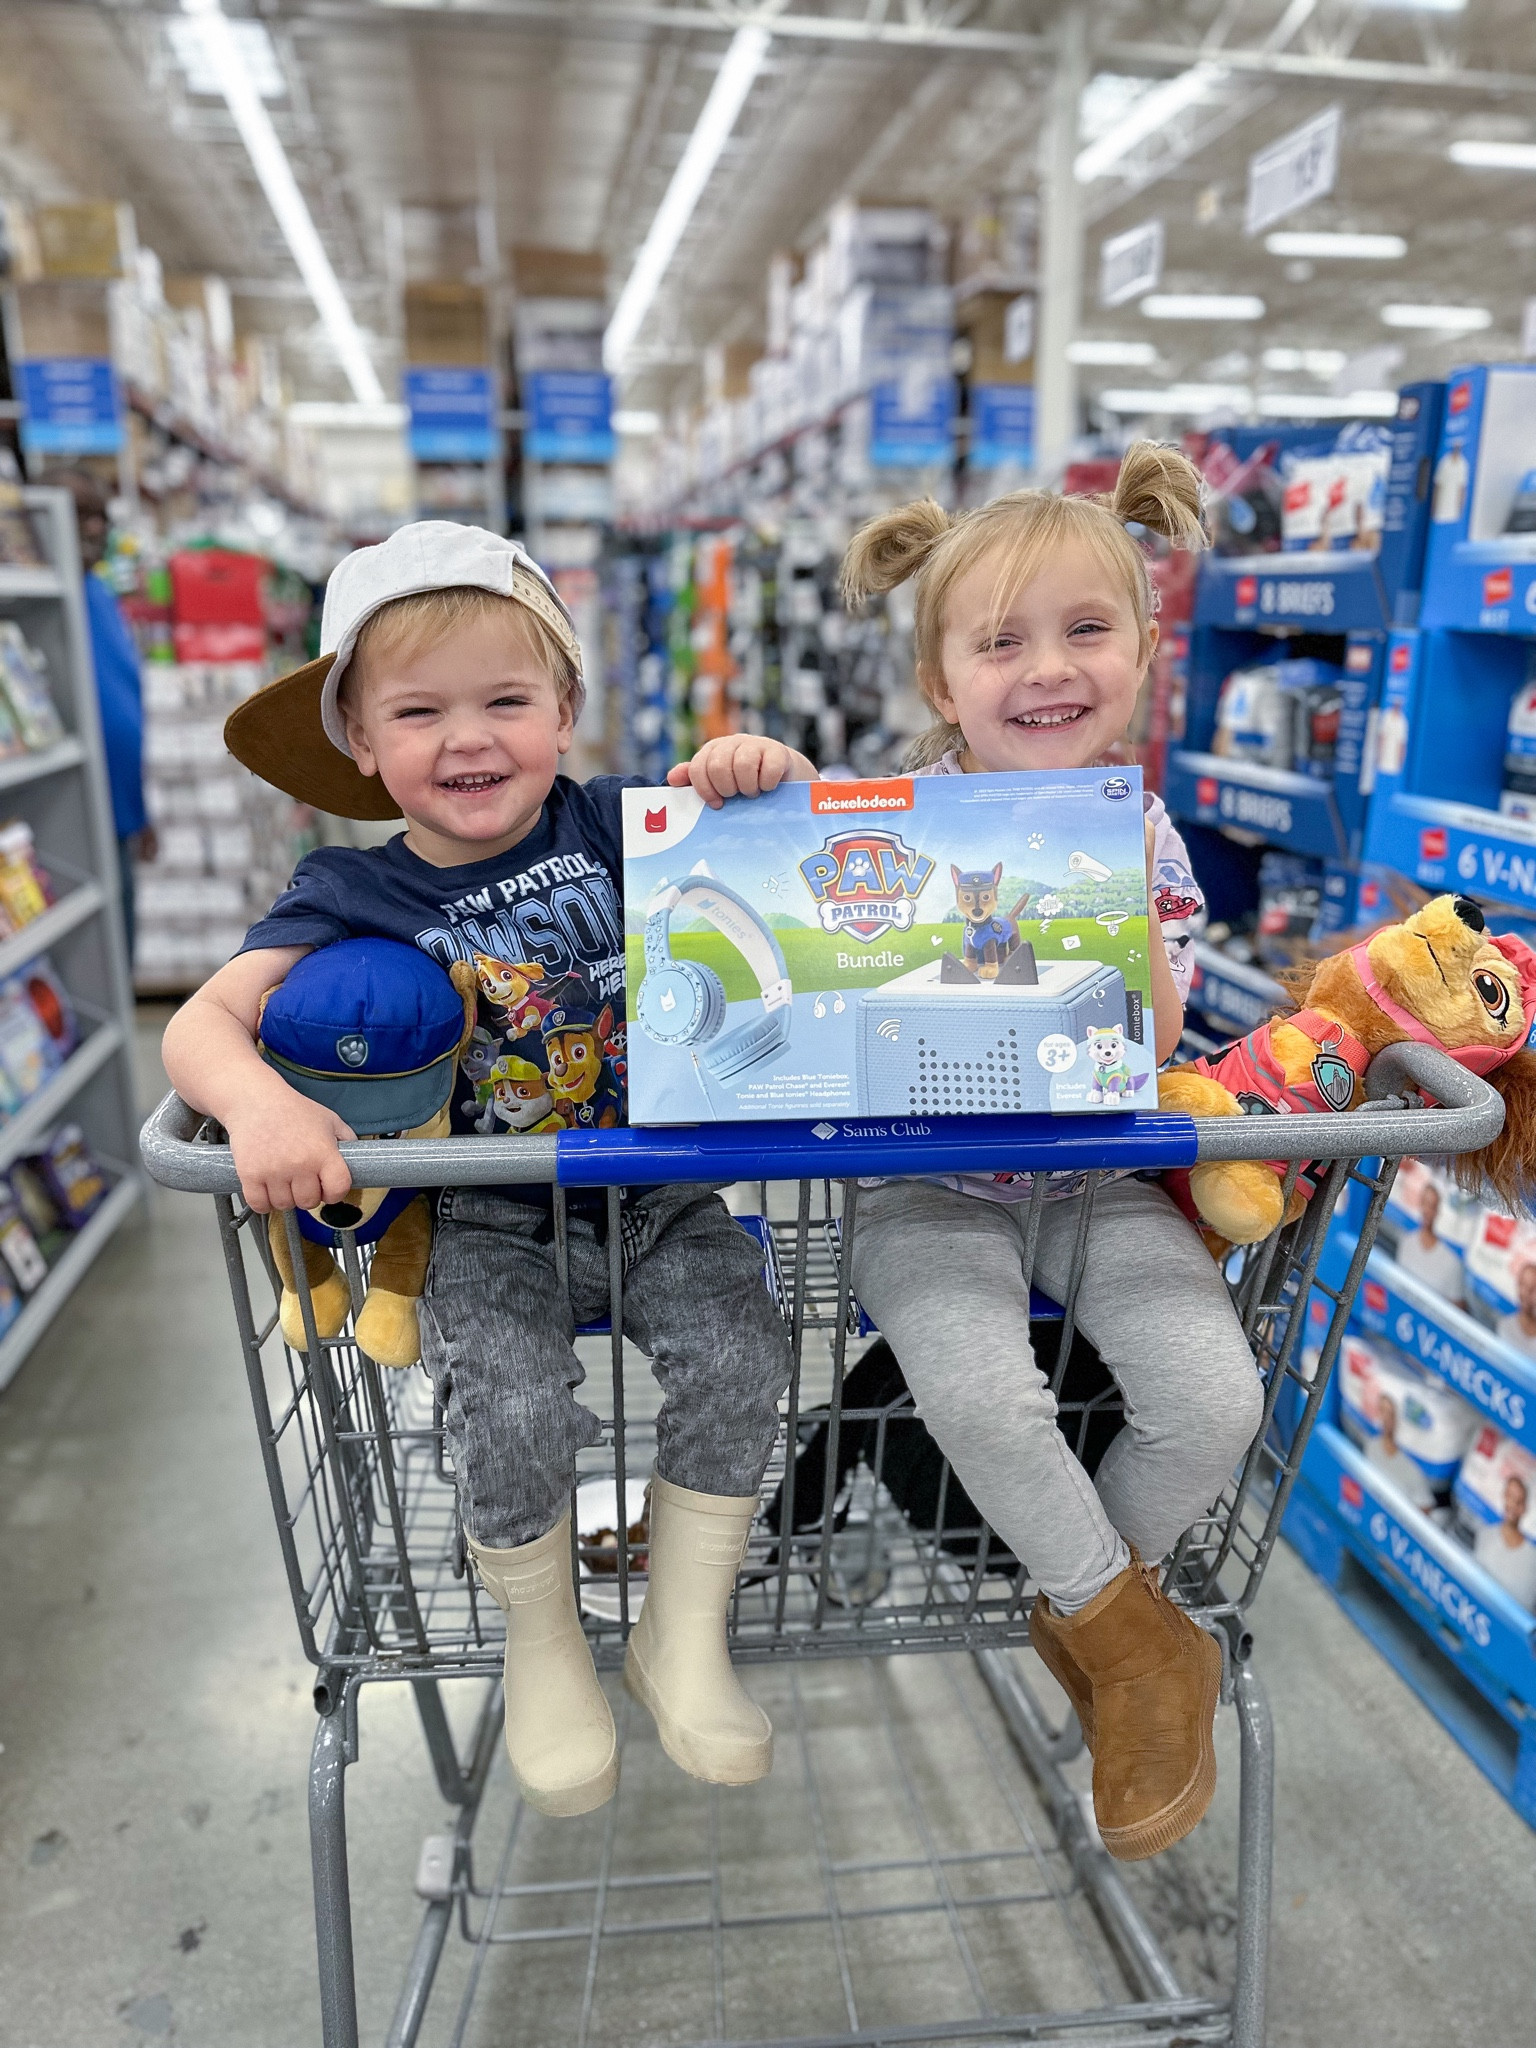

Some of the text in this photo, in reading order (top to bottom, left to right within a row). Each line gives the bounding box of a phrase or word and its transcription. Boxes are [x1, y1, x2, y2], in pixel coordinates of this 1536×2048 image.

[818, 794, 907, 811] nickelodeon
[798, 848, 935, 903] PAW
[1457, 842, 1478, 880] 6
[1482, 847, 1536, 897] V-N
[440, 851, 601, 924] PAW PATROL
[711, 906, 747, 940] tonies
[831, 903, 902, 922] PATROL
[589, 952, 626, 982] HERE
[836, 950, 905, 969] Bundle
[1131, 998, 1142, 1041] toniebox
[1045, 1049, 1070, 1067] 3+
[773, 1074, 800, 1082] Includes
[810, 1090, 850, 1098] Headphones
[842, 1121, 931, 1138] Sam's Club
[1395, 1311, 1414, 1343] 6
[1416, 1322, 1526, 1430] V-NECKS
[1370, 1511, 1492, 1647] 6 V-NECKS
